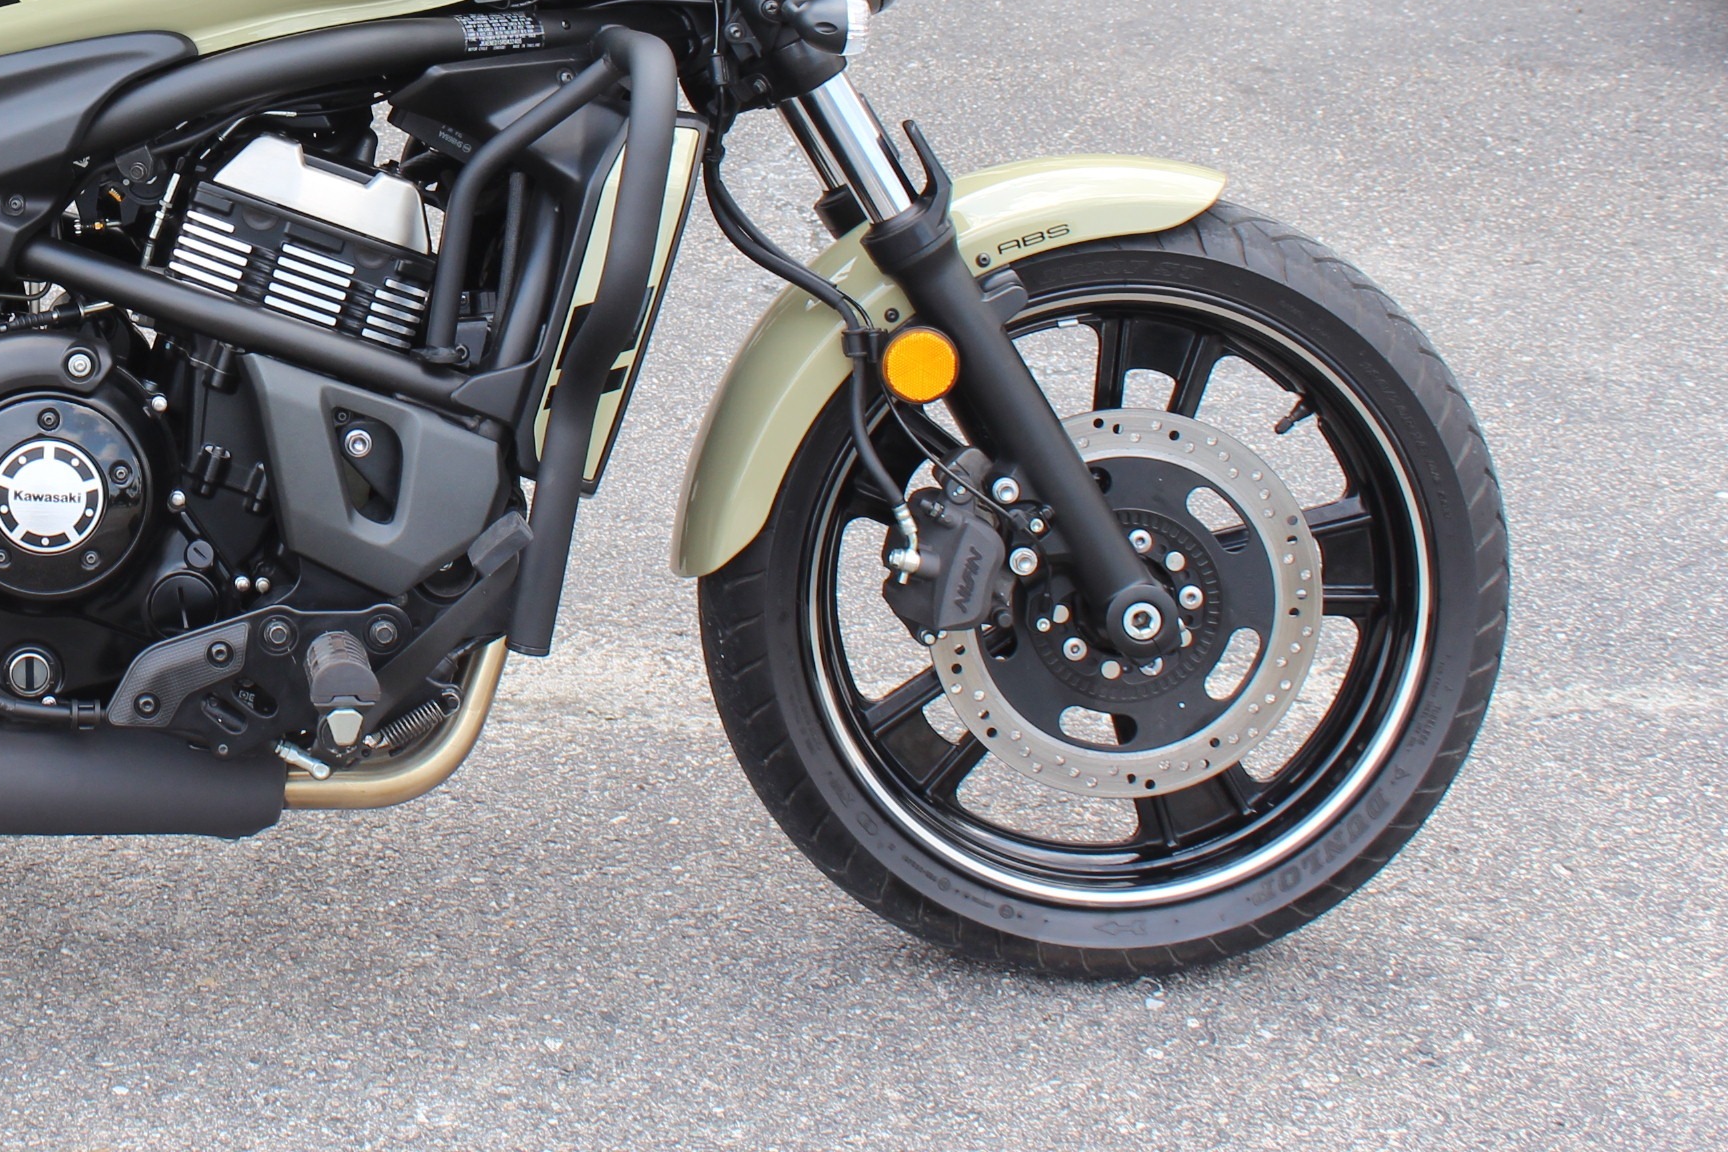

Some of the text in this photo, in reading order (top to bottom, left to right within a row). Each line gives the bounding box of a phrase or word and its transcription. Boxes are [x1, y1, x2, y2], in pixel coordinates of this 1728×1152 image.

[997, 223, 1070, 255] ABS
[13, 489, 82, 503] Kawasaki
[1250, 786, 1391, 907] DUNLOP
